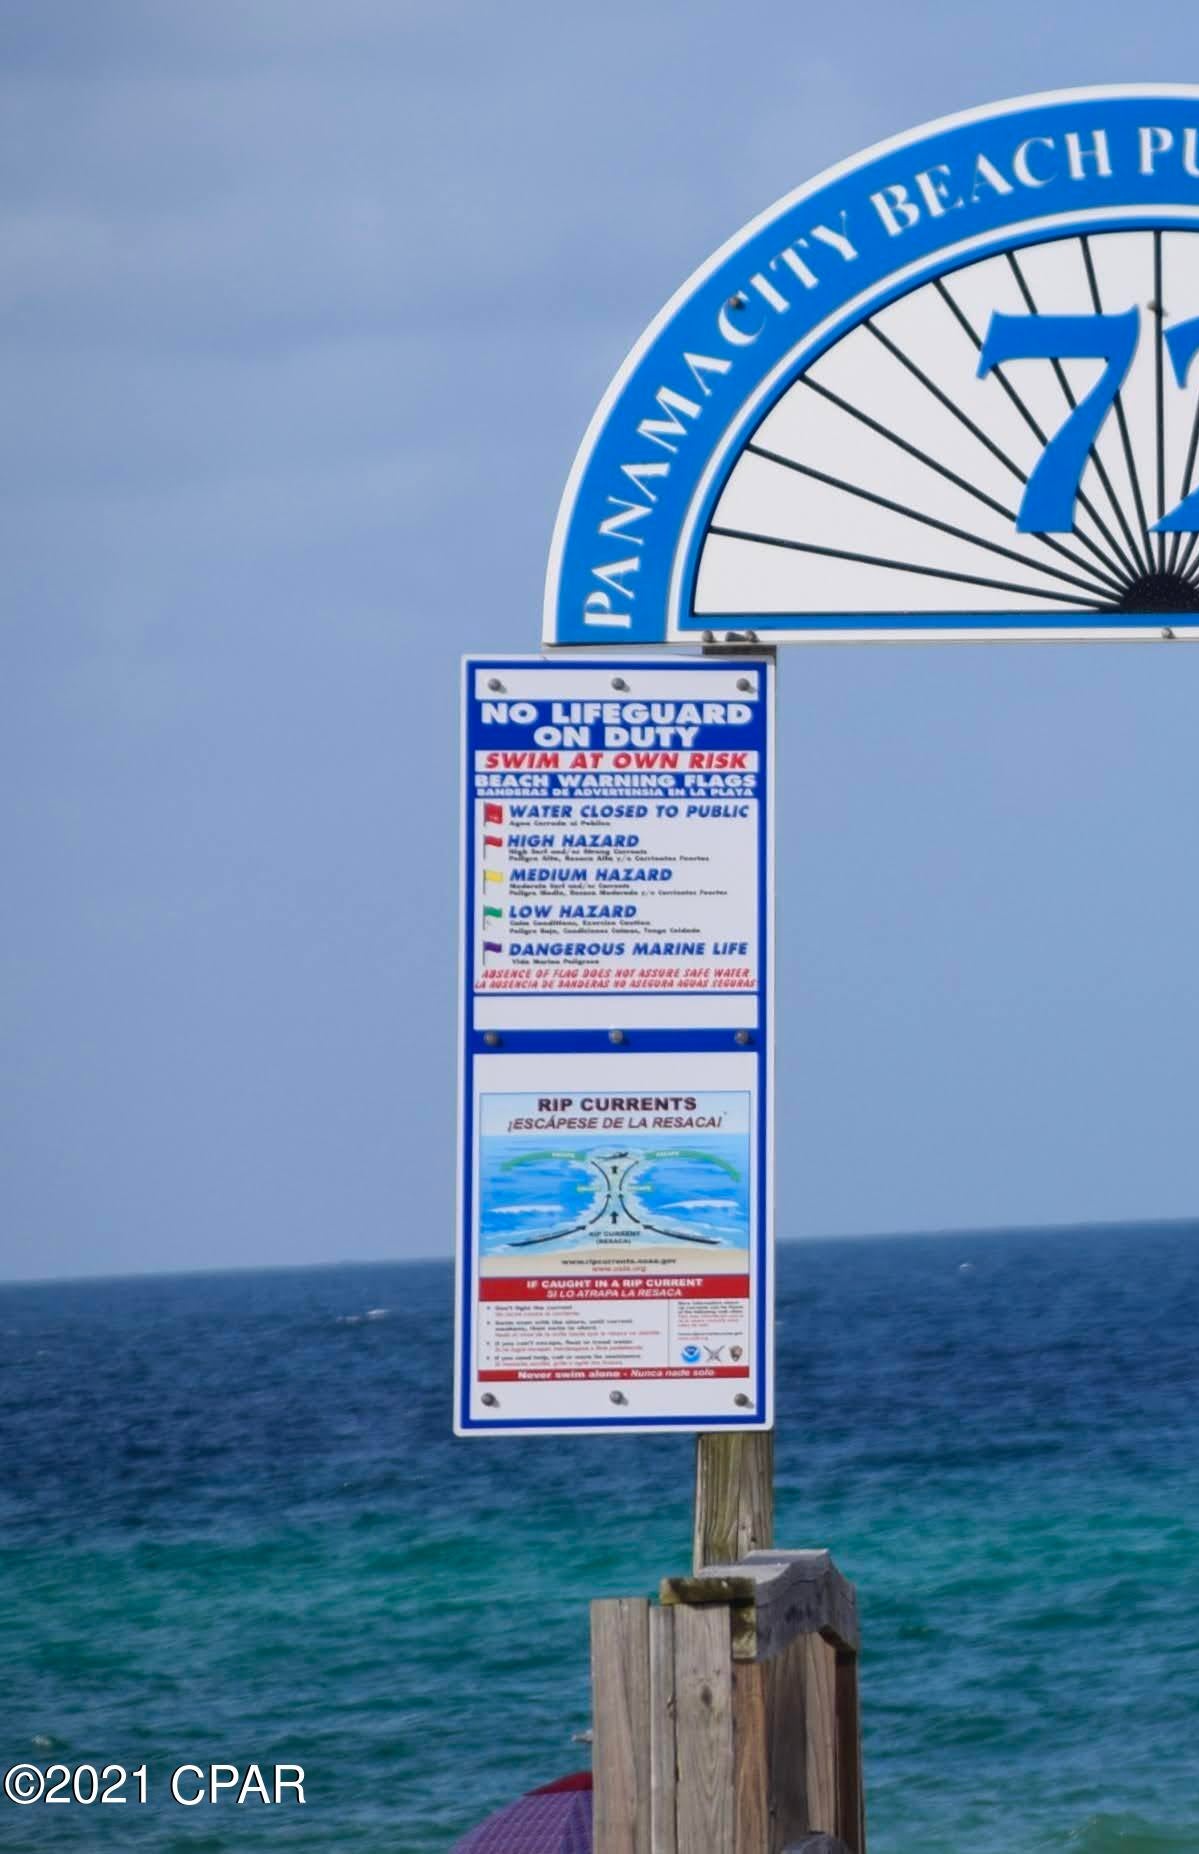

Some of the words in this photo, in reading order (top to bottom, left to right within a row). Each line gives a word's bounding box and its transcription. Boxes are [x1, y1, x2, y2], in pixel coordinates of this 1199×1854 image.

[583, 351, 732, 629] PANAMA
[717, 211, 859, 347] CITY
[869, 129, 1113, 237] BEACH
[481, 703, 537, 724] NO
[552, 703, 752, 724] LIFEGUARD
[534, 726, 590, 747] ON
[605, 726, 699, 747] DUTY
[485, 753, 559, 769] SWIM
[570, 753, 603, 769] AT
[612, 753, 679, 769] OWN
[689, 753, 748, 769] RISK
[475, 774, 548, 787] BEACH
[558, 774, 676, 787] WARNING
[684, 774, 756, 787] FLAGS
[509, 805, 572, 818] WATER
[580, 805, 648, 818] CLOSED
[656, 805, 679, 818] TO
[686, 805, 749, 818] PUBLIC
[508, 835, 554, 847] HIGH
[562, 835, 639, 847] HAZARD
[510, 868, 587, 881] MEDIUM
[595, 868, 672, 881] HAZARD
[509, 905, 552, 918] LOW
[560, 905, 637, 918] HAZARD
[509, 943, 625, 955] DANGEROUS
[632, 942, 705, 955] MARINE
[713, 942, 748, 955] LIFE
[538, 1098, 573, 1112] RIP
[580, 1097, 697, 1111] CURRENTS
[507, 1115, 597, 1132] ¡ESCÁPESE
[602, 1117, 625, 1129] DE
[628, 1117, 648, 1129] LA
[527, 1281, 537, 1289] IF
[541, 1280, 591, 1289] CAUGHT
[594, 1280, 608, 1288] IN
[611, 1280, 620, 1288] A
[622, 1280, 642, 1288] RIP
[646, 1278, 702, 1288] CURRENT
[547, 1290, 558, 1298] SI
[560, 1290, 575, 1298] LO
[576, 1290, 619, 1298] ATRAPA
[621, 1289, 635, 1297] LA
[637, 1288, 682, 1297] RESACA
[518, 1371, 551, 1380] Never
[555, 1371, 584, 1379] swim
[587, 1370, 620, 1379] alone
[630, 1369, 662, 1377] Nunca
[665, 1369, 690, 1377] nade
